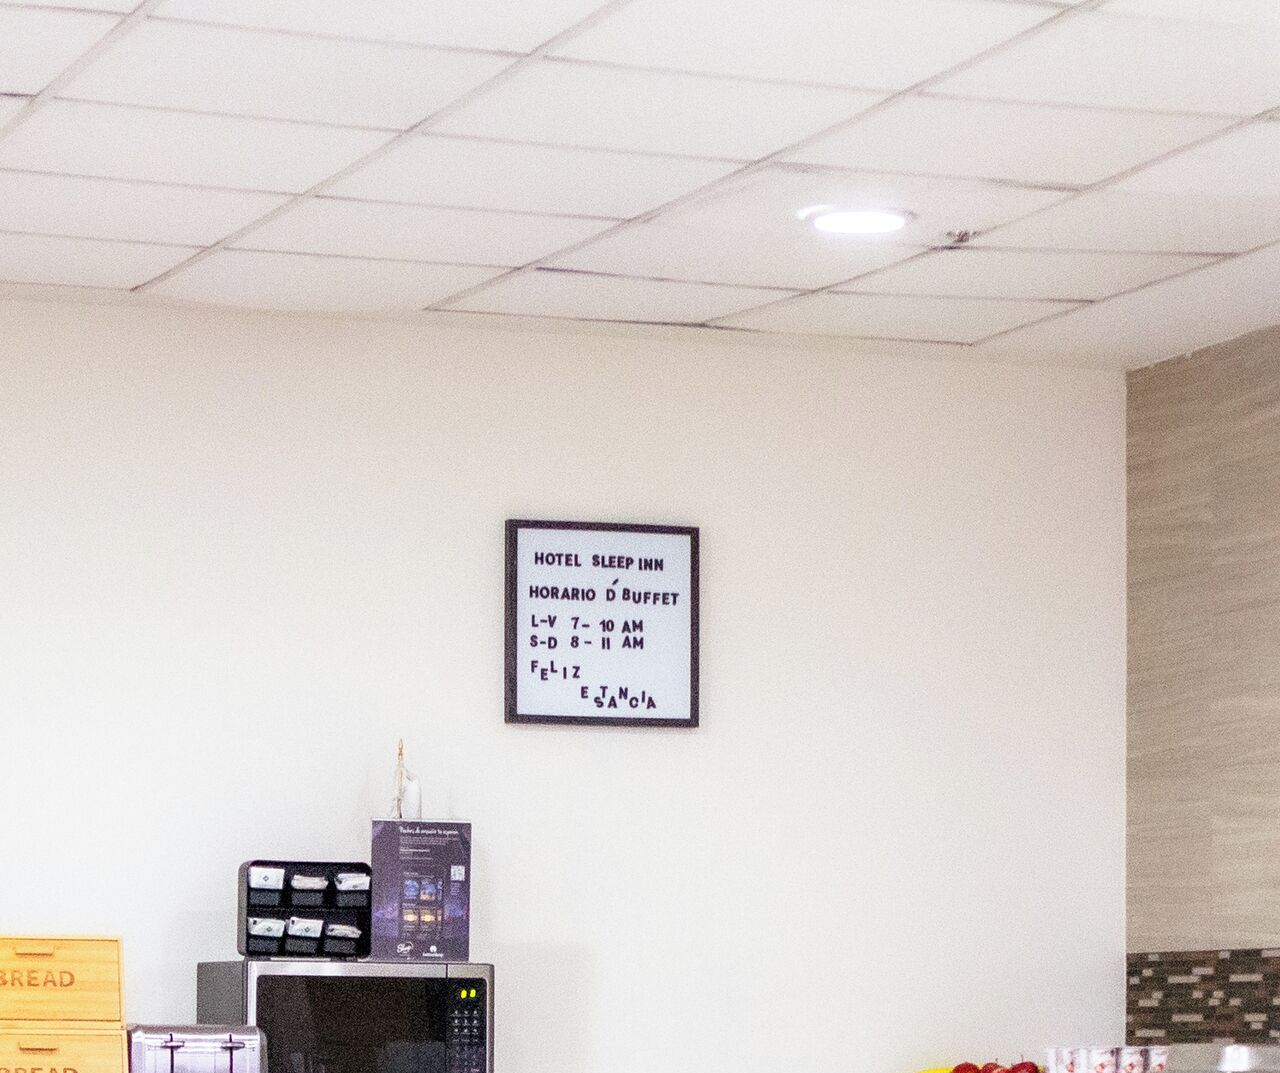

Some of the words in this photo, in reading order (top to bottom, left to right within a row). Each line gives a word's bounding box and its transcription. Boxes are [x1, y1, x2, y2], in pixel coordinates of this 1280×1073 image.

[534, 552, 582, 567] HOTEL
[591, 554, 634, 570] SLEEP
[638, 557, 664, 571] INN
[529, 585, 596, 601] HORARIO
[622, 587, 680, 605] BUFFET
[531, 614, 557, 628] L-V
[599, 619, 614, 632] 10
[621, 619, 644, 633] AM
[529, 634, 558, 649] S-D
[622, 635, 644, 650] AM
[530, 660, 581, 681] FELIZ
